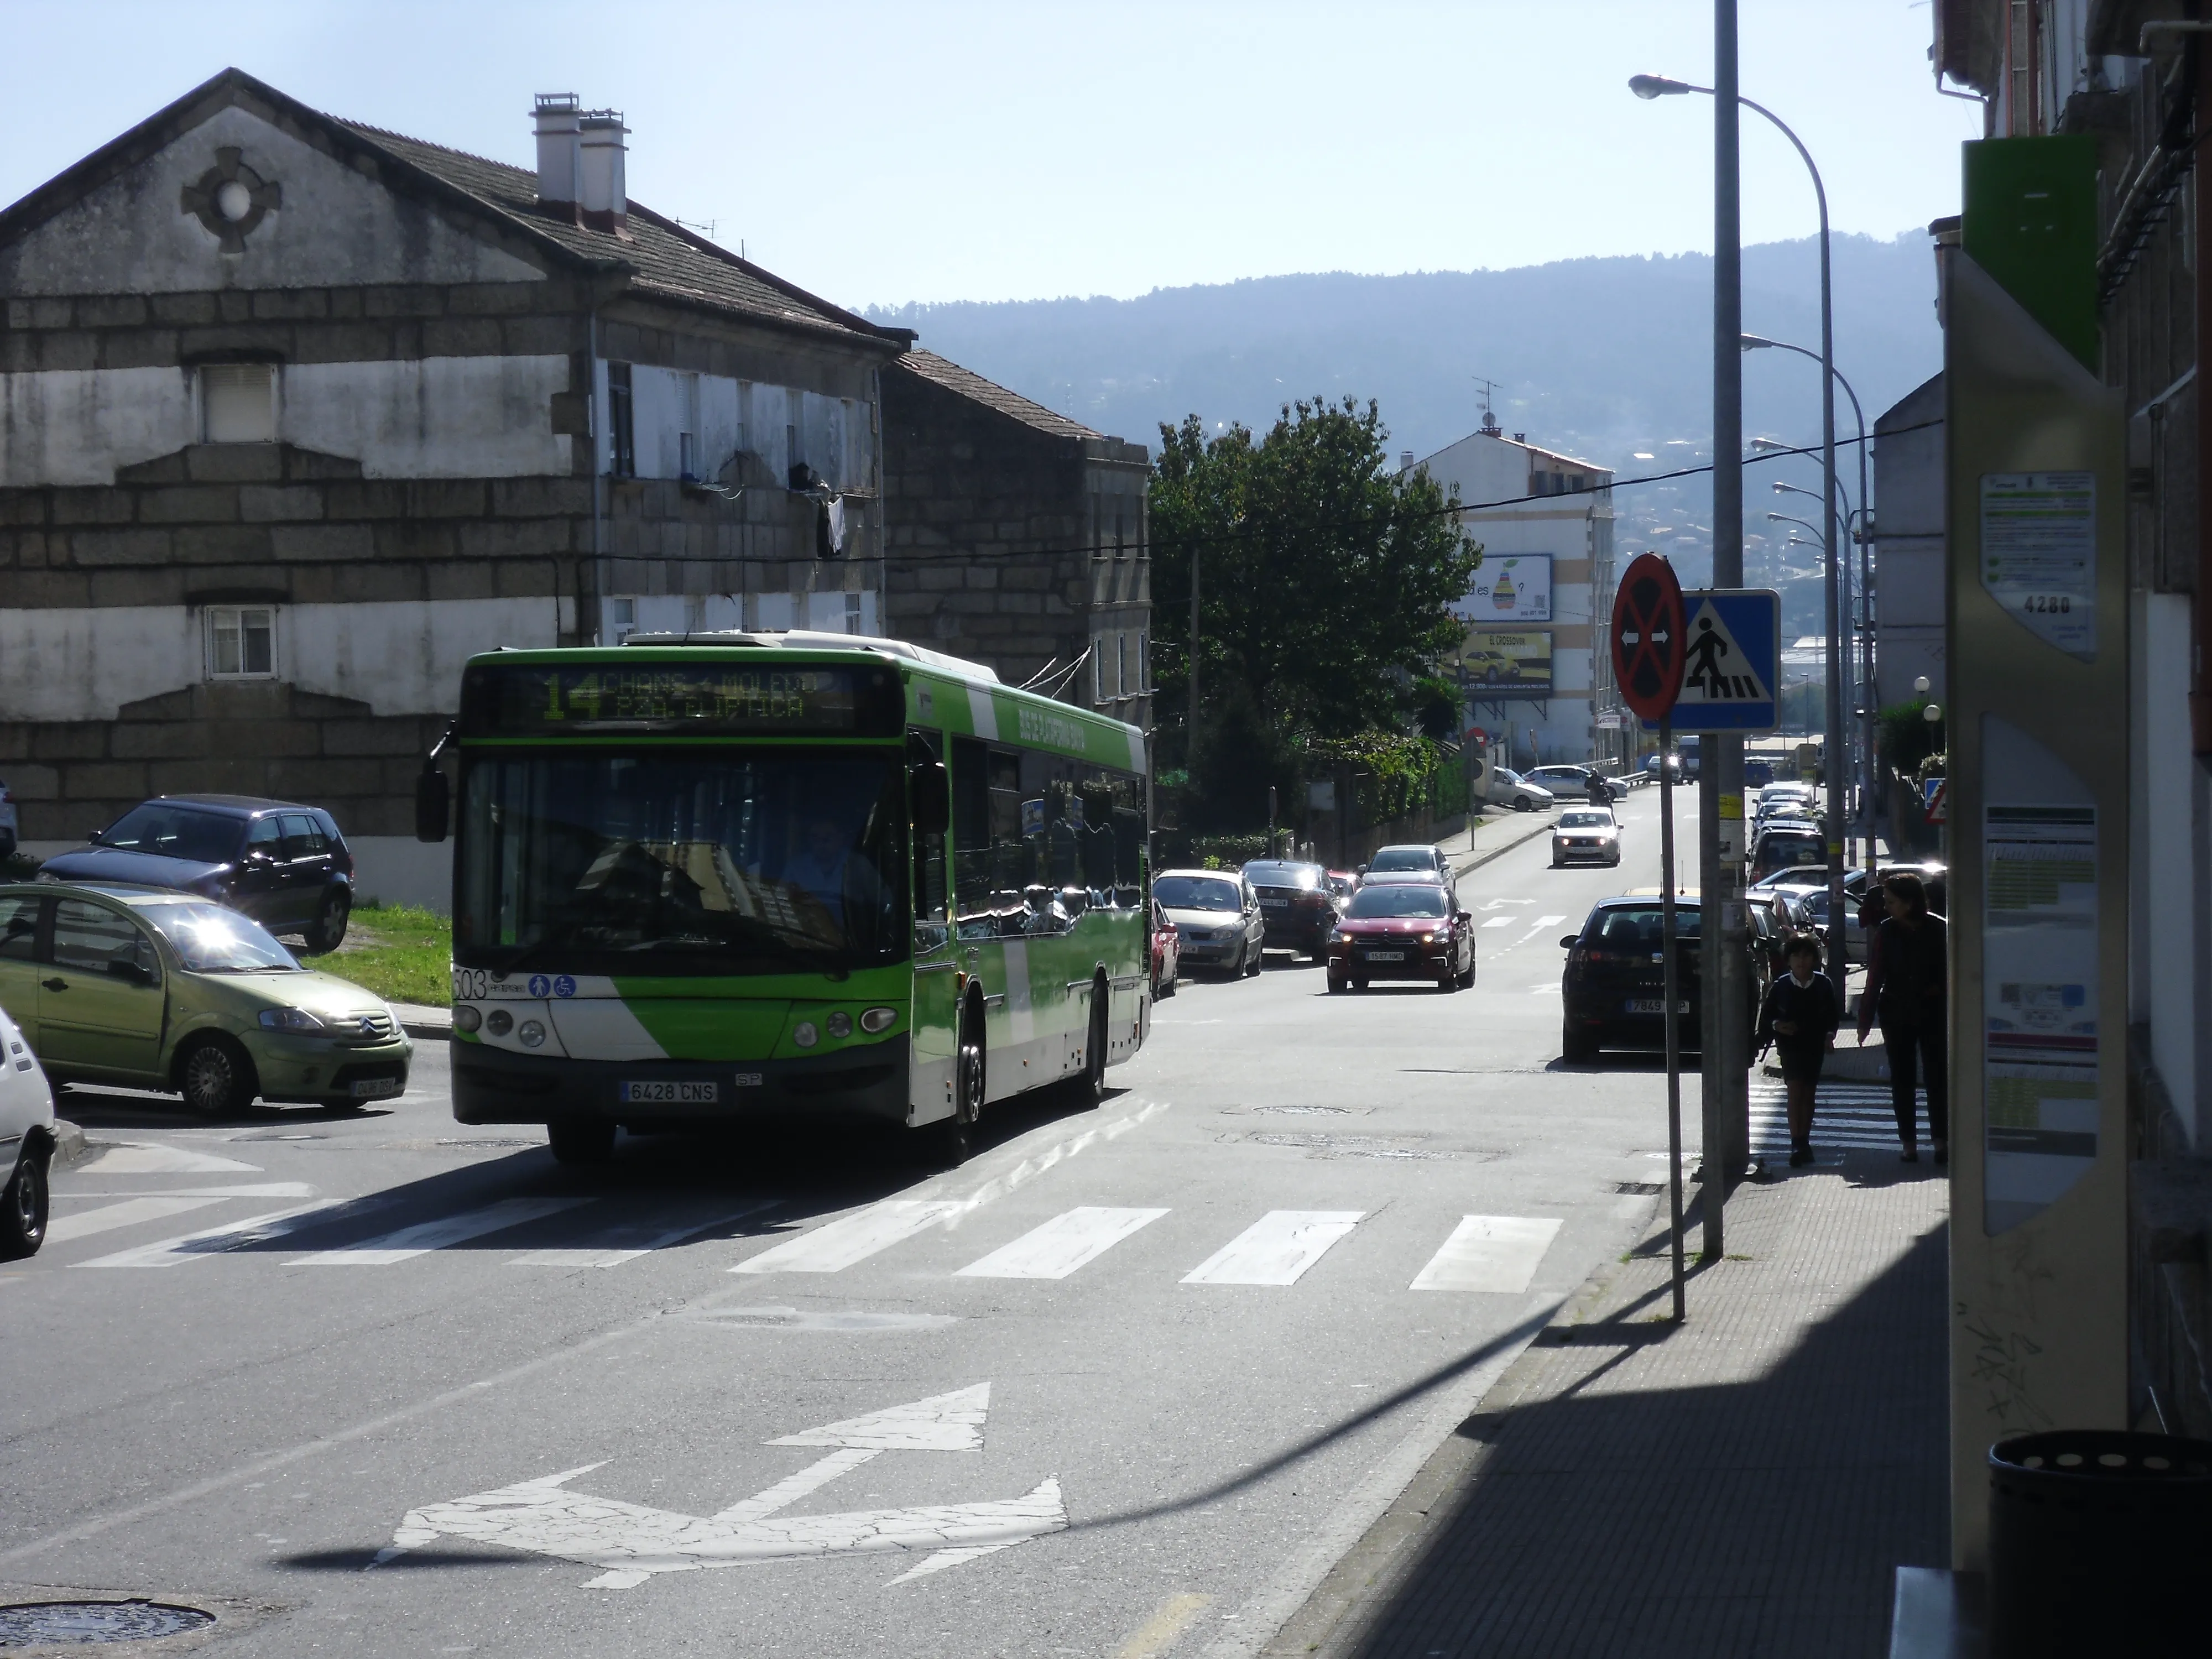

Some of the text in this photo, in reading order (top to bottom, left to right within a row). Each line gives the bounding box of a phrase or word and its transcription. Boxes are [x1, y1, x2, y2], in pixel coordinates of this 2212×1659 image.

[2024, 596, 2070, 614] 4280
[722, 672, 817, 693] MOLEDO
[544, 673, 601, 720] 14
[685, 696, 803, 717] ELIPTICA
[1634, 1000, 1661, 1011] 7849
[738, 1074, 760, 1086] SP
[632, 1084, 713, 1100] 6428 CNS
